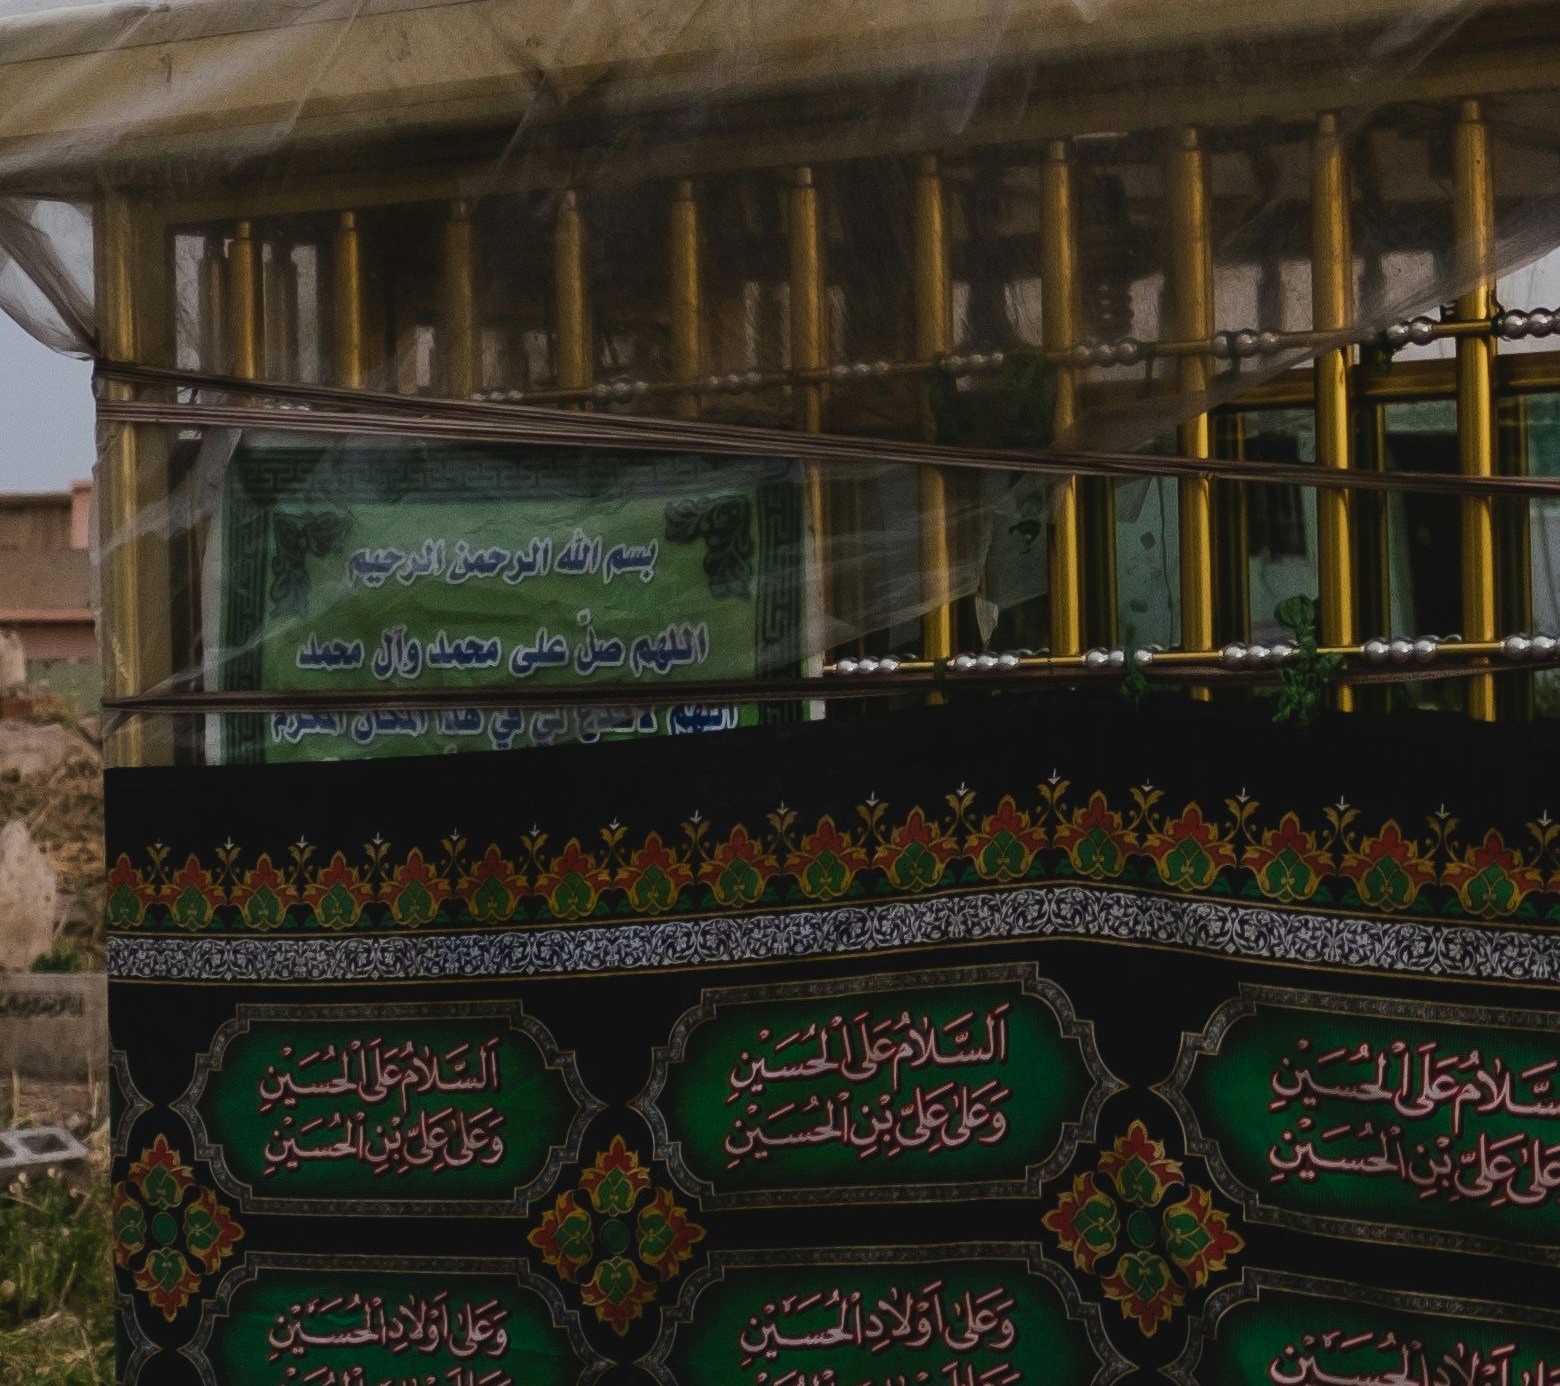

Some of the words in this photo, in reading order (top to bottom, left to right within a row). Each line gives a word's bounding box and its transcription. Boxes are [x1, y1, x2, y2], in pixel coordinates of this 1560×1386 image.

[345, 538, 444, 588] الرحيم
[446, 537, 551, 584] الرحمن
[554, 528, 603, 575] الله
[603, 538, 658, 584] بسم
[296, 633, 364, 670] محمد
[427, 629, 502, 669] محمد
[509, 627, 568, 678] على
[632, 622, 709, 678] اللهم
